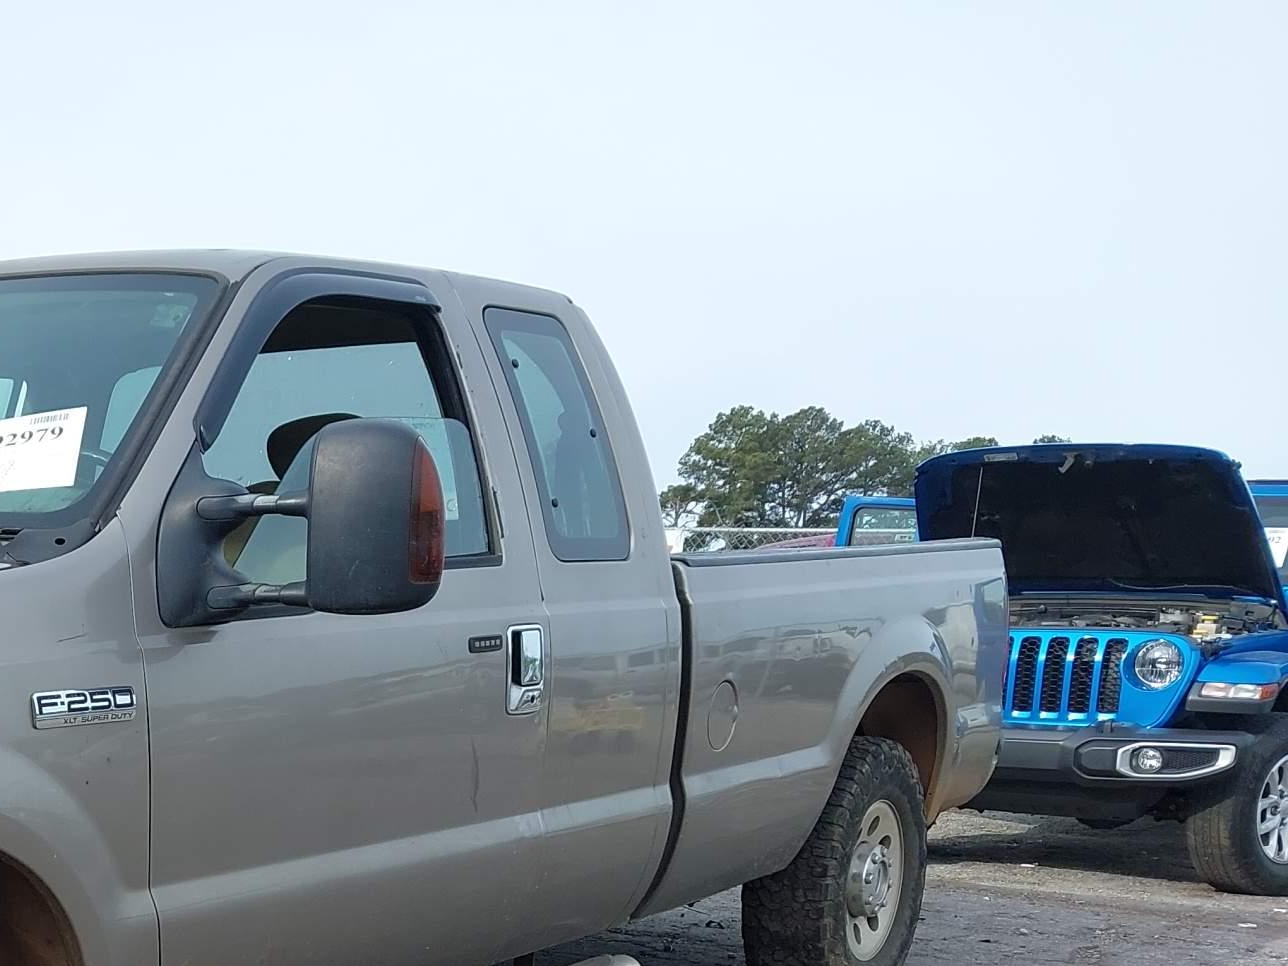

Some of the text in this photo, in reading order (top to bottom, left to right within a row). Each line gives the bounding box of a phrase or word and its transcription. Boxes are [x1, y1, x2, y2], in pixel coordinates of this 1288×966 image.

[36, 688, 135, 715] F-250
[63, 712, 133, 725] XLT SUPER DUTY
